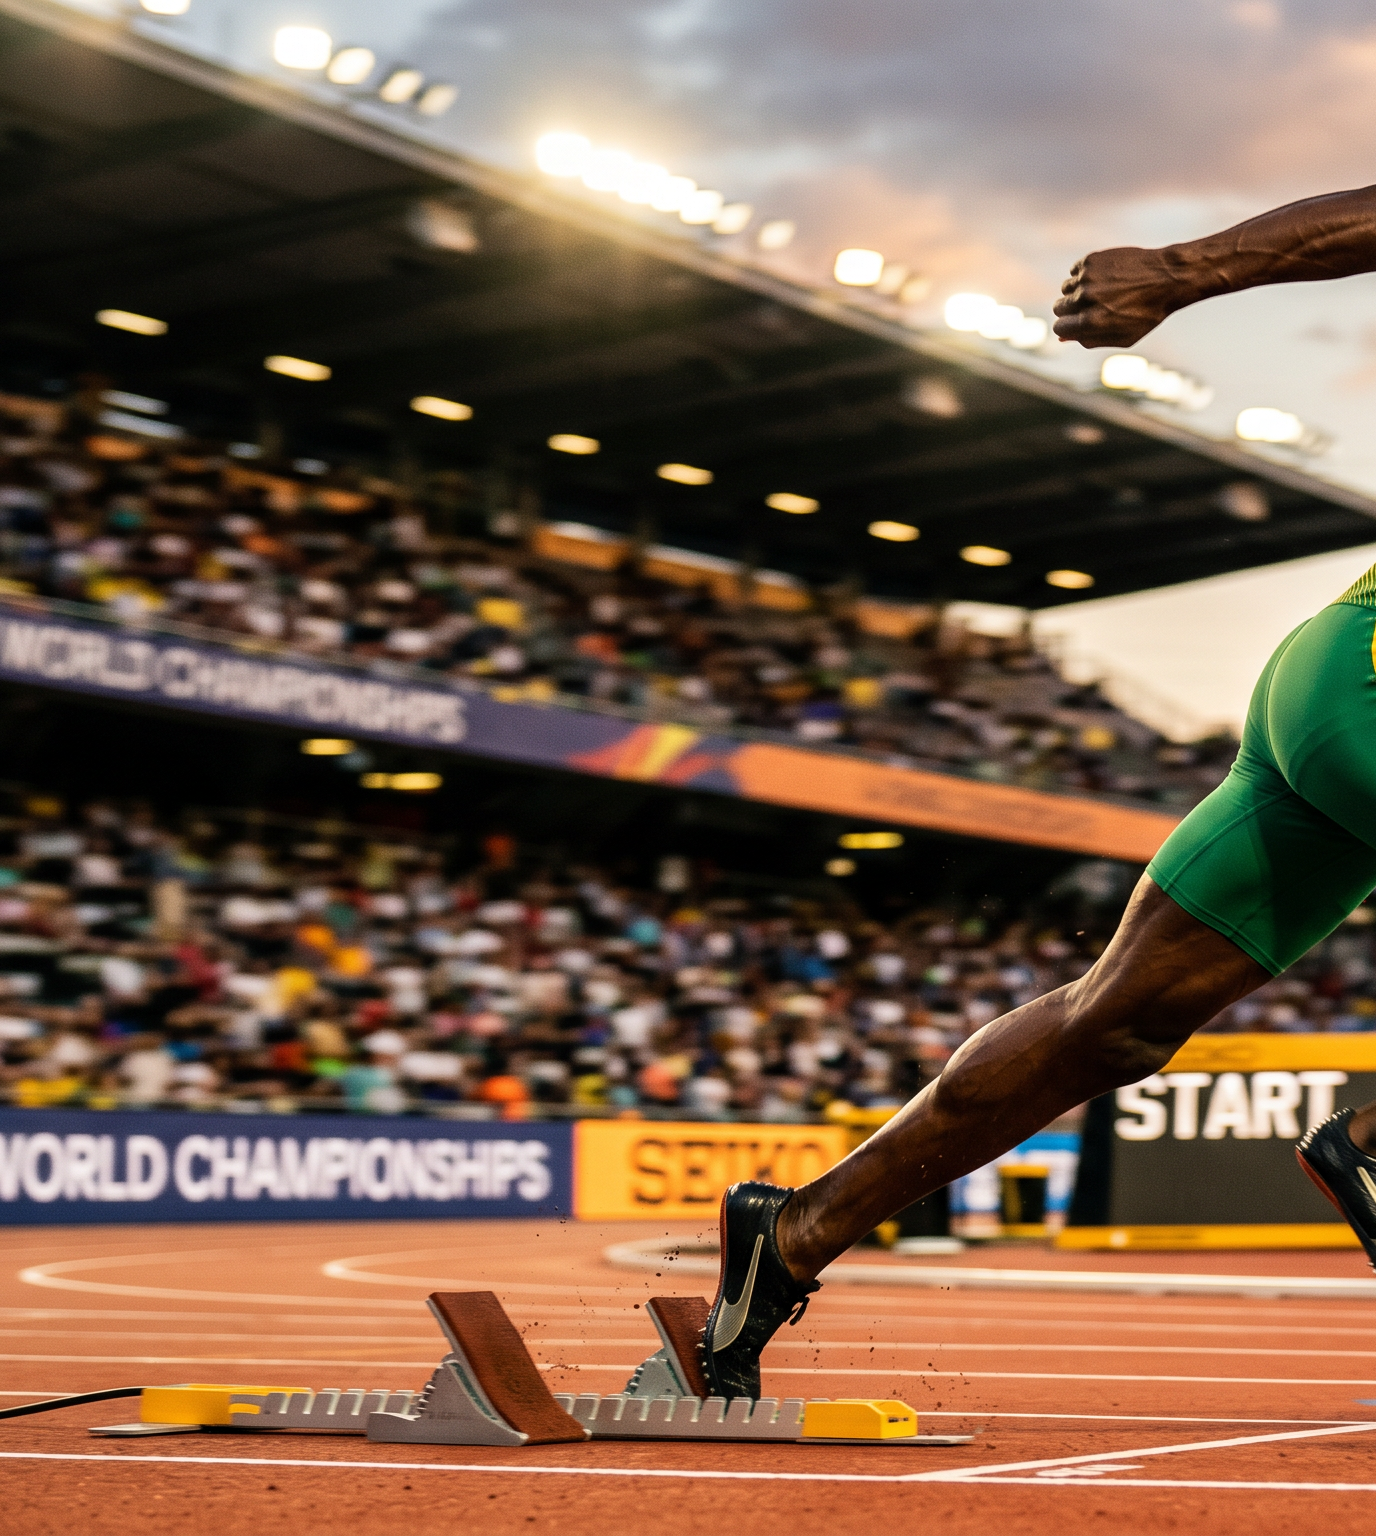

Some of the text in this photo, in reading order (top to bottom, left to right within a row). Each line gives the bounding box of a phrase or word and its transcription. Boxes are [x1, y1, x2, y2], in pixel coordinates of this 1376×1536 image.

[1114, 1071, 1348, 1140] START
[174, 1134, 551, 1201] CHAMPIONSHIPS
[633, 1137, 828, 1204] SEIKO
